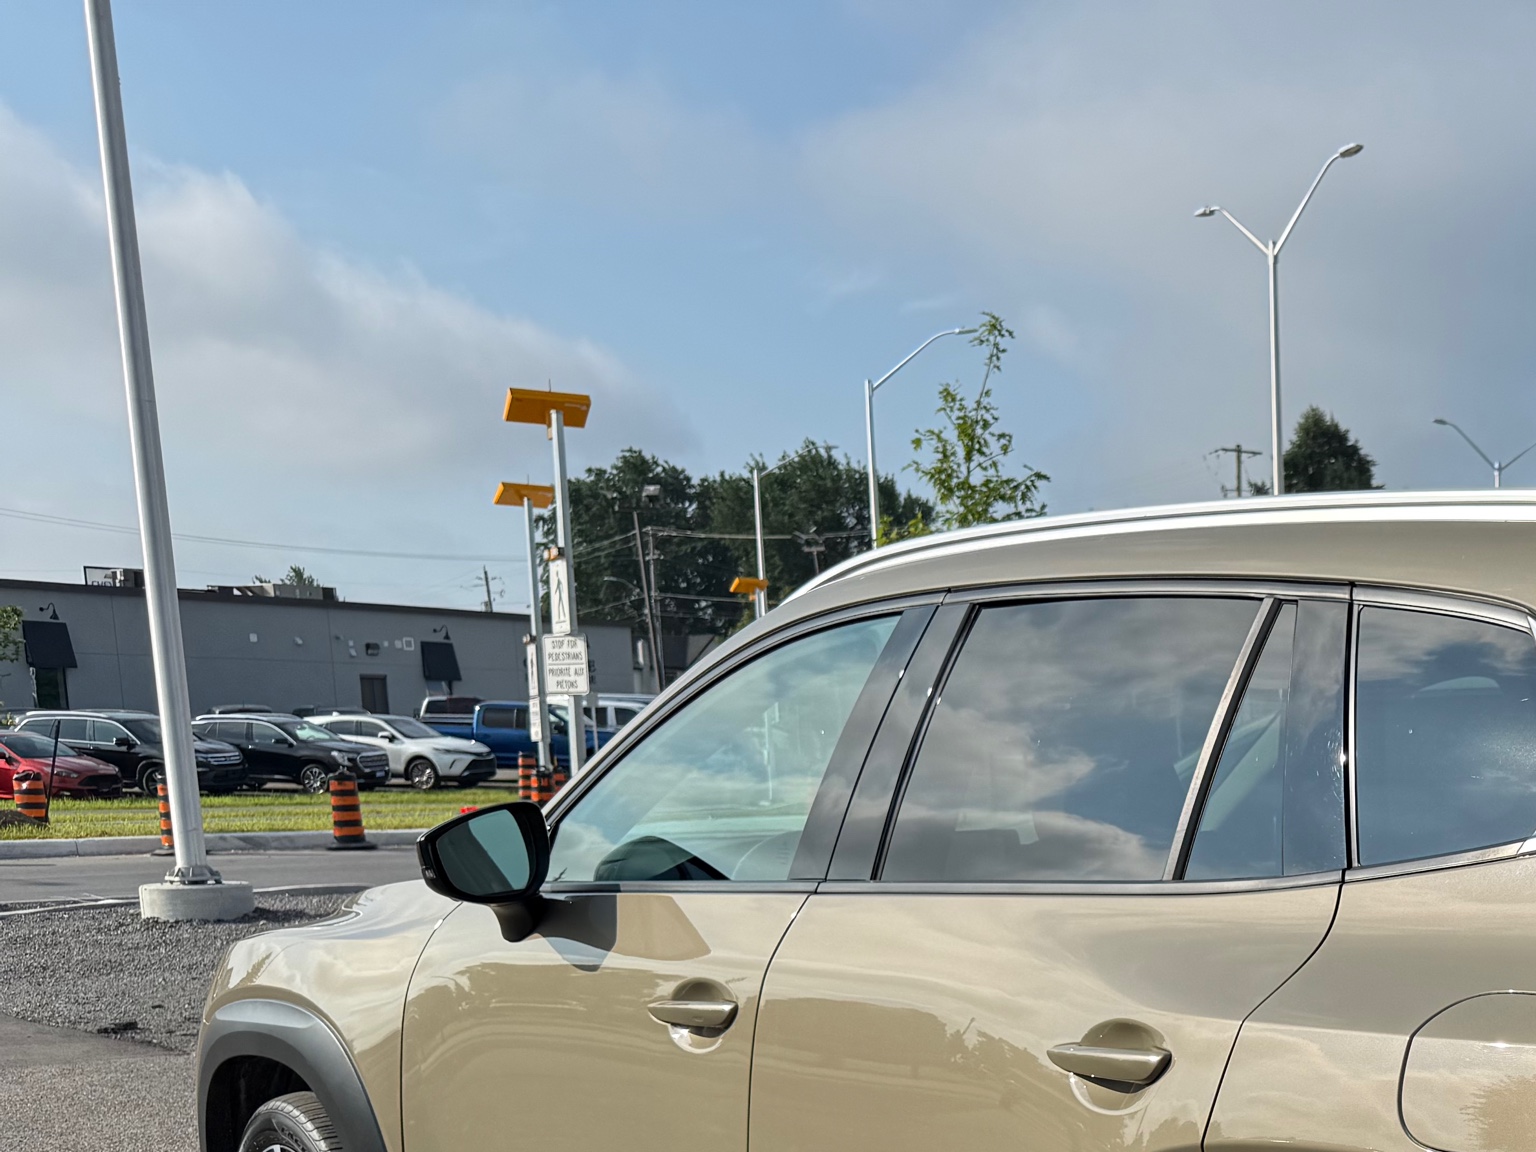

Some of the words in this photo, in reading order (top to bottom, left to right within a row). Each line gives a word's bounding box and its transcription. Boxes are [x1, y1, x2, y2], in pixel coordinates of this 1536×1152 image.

[551, 639, 565, 650] STOP
[567, 638, 578, 649] FOR
[547, 651, 583, 662] PEDESTRIANS
